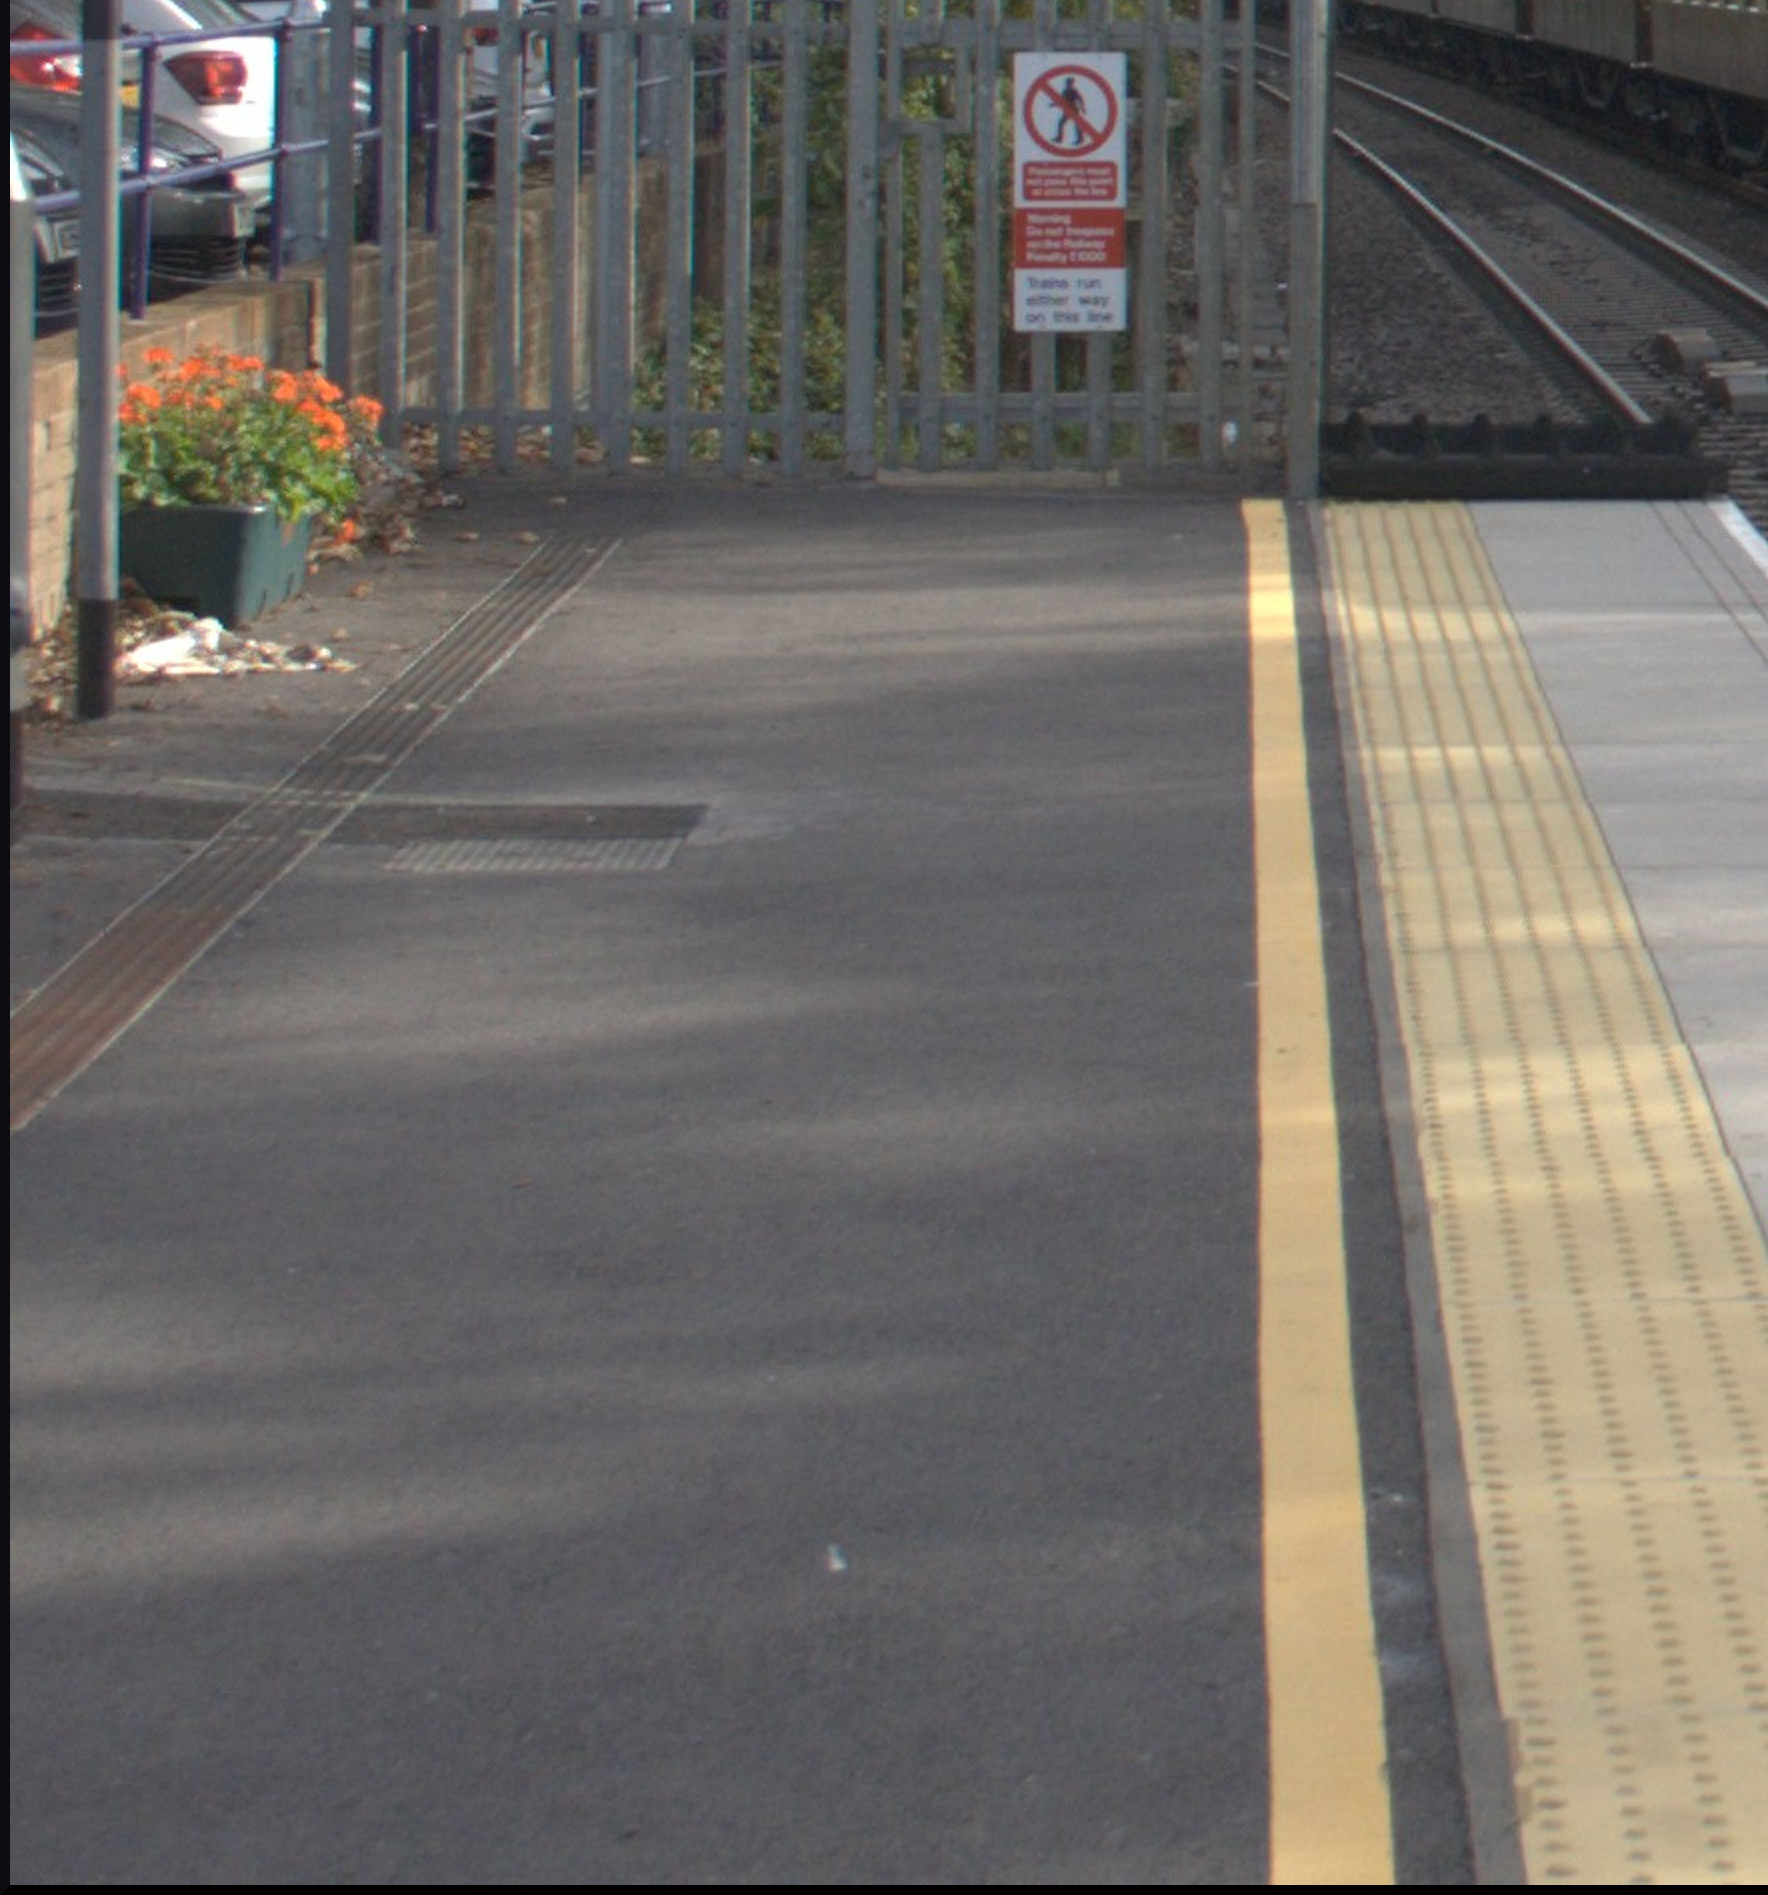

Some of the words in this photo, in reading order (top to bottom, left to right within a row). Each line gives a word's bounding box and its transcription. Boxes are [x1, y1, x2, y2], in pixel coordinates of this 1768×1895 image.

[1044, 227, 1064, 236] not
[1027, 276, 1069, 289] Trains
[1077, 278, 1102, 289] run
[1026, 293, 1069, 306] either
[1078, 295, 1110, 308] way
[1025, 312, 1045, 323] on
[1053, 311, 1079, 323] this
[1087, 311, 1114, 323] line
